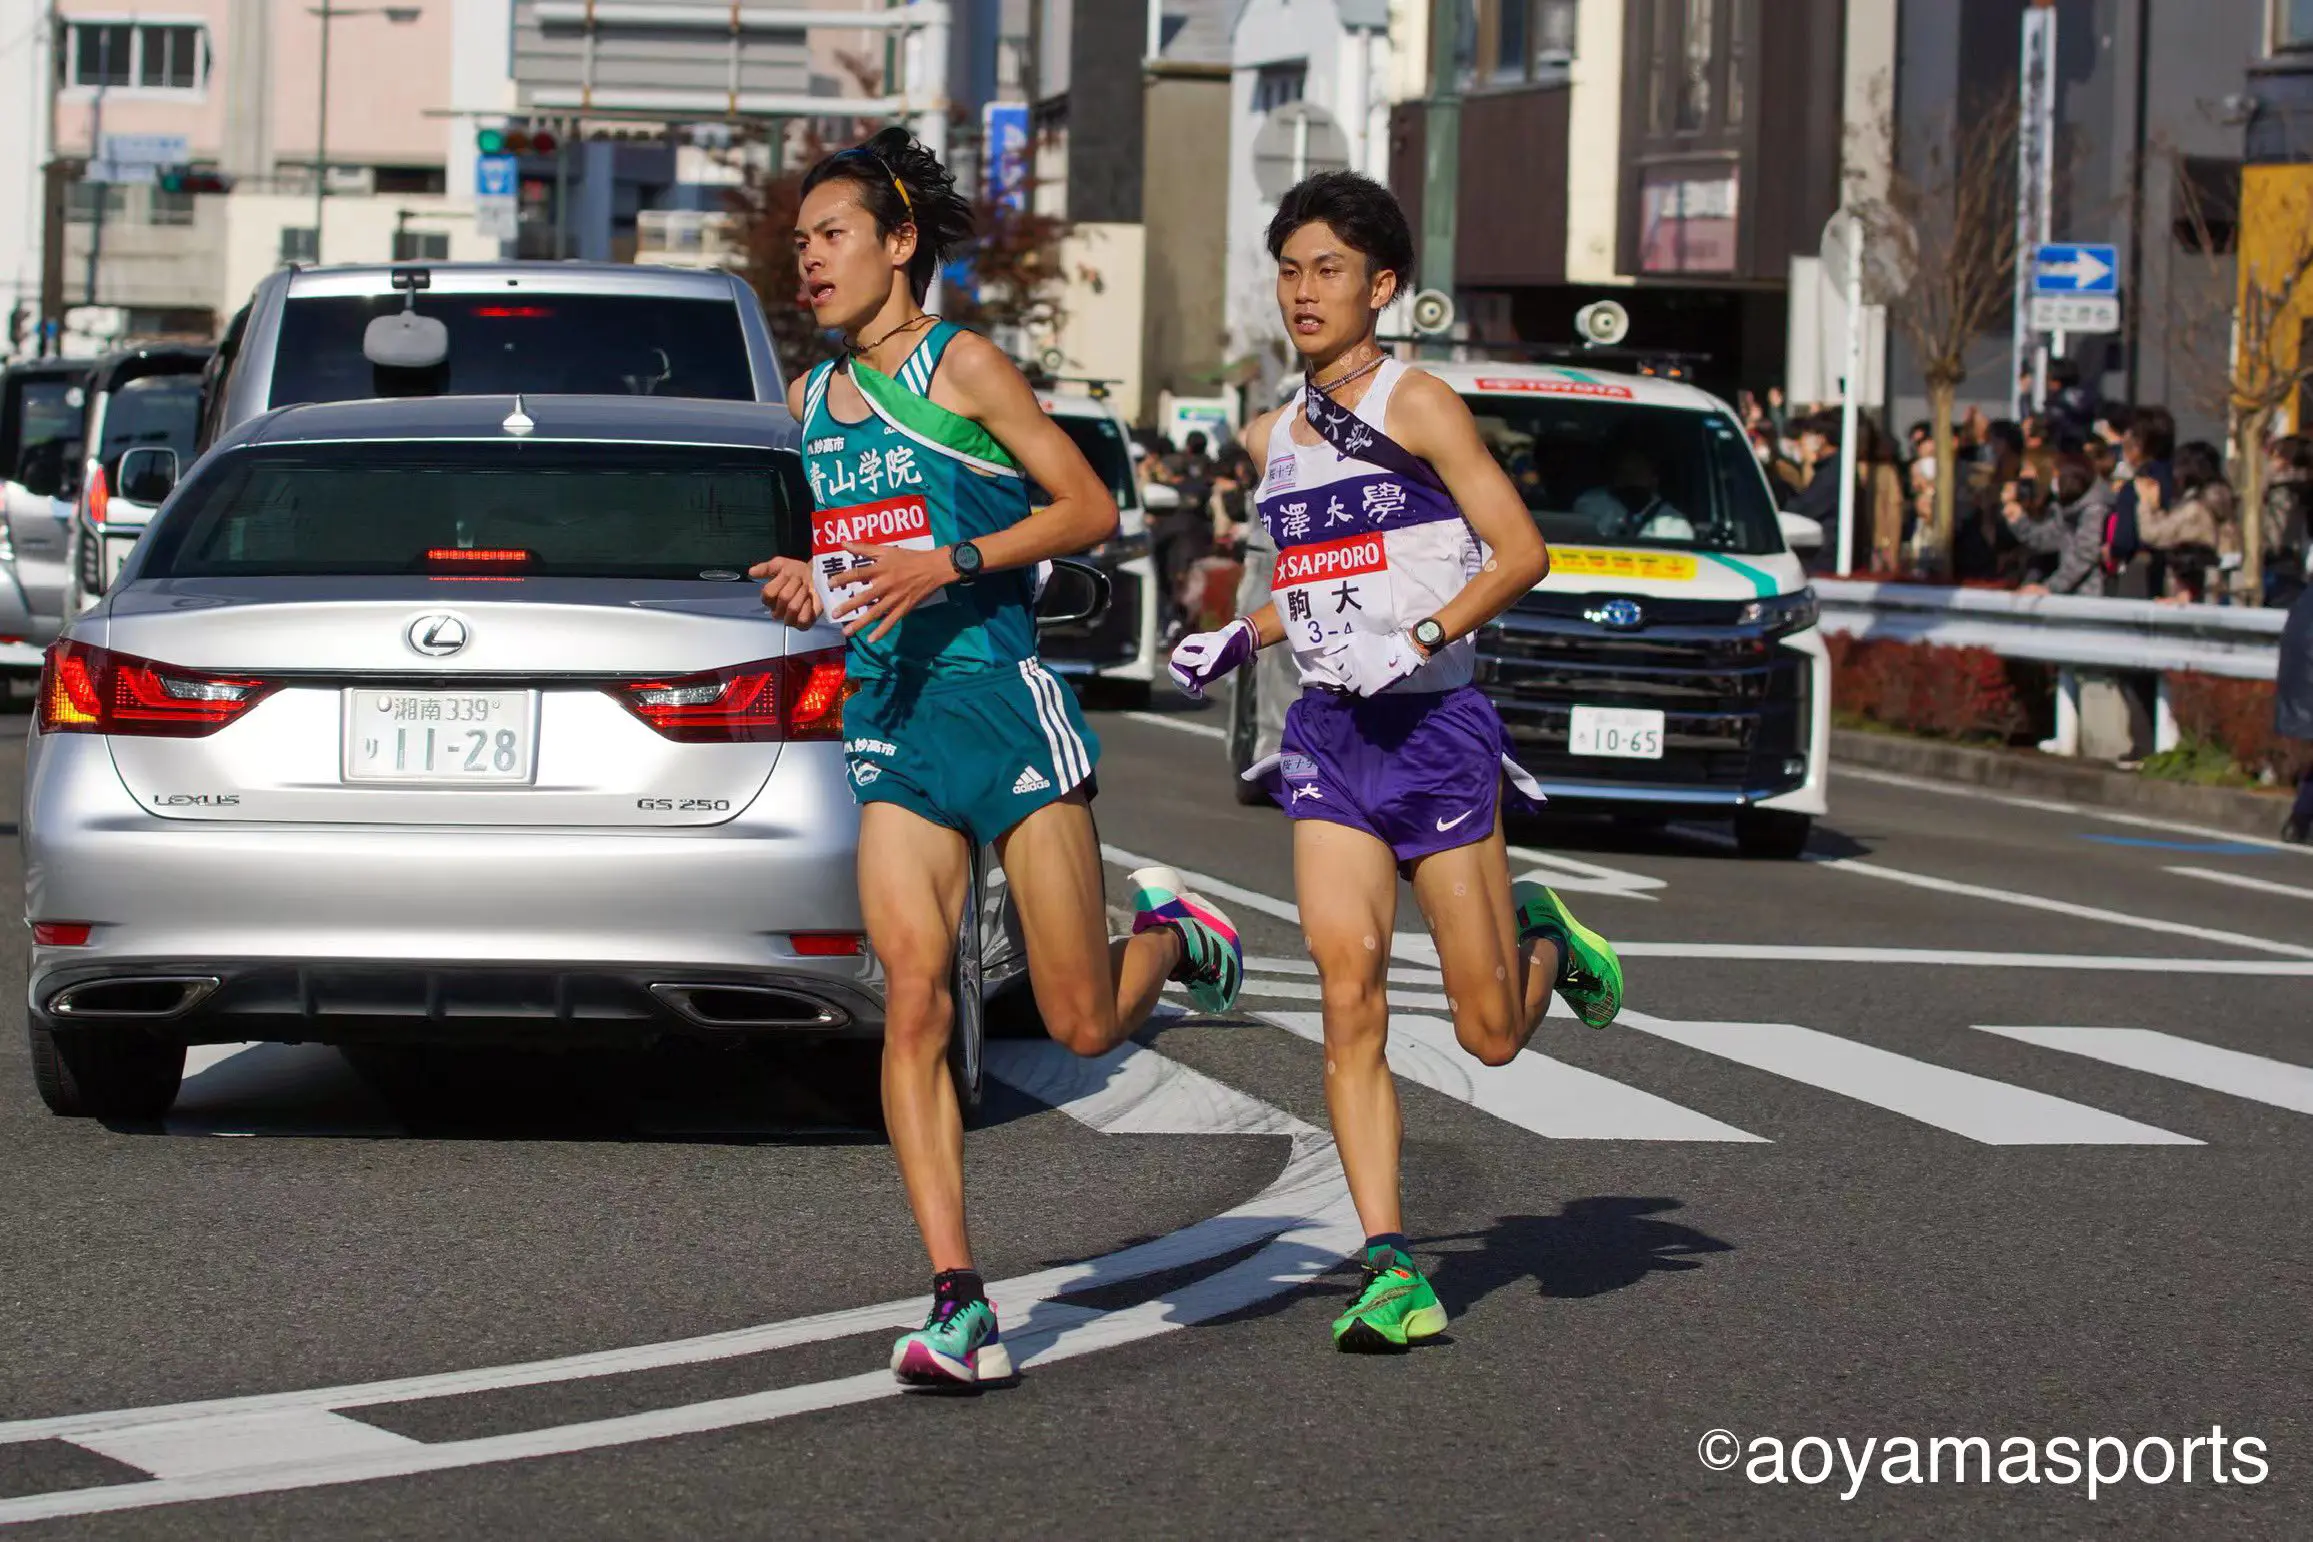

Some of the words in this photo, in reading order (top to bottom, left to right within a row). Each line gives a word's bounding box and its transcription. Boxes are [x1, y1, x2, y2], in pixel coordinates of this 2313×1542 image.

[824, 505, 925, 545] SAPPORO
[1287, 543, 1379, 578] SAPPORO
[394, 697, 441, 721] 湘南
[446, 697, 489, 722] 339
[396, 727, 517, 772] 11-28
[1595, 728, 1657, 753] 10-65
[1012, 779, 1050, 795] adidas
[154, 794, 241, 807] LEXUS
[637, 798, 673, 811] GS
[678, 798, 731, 812] 250
